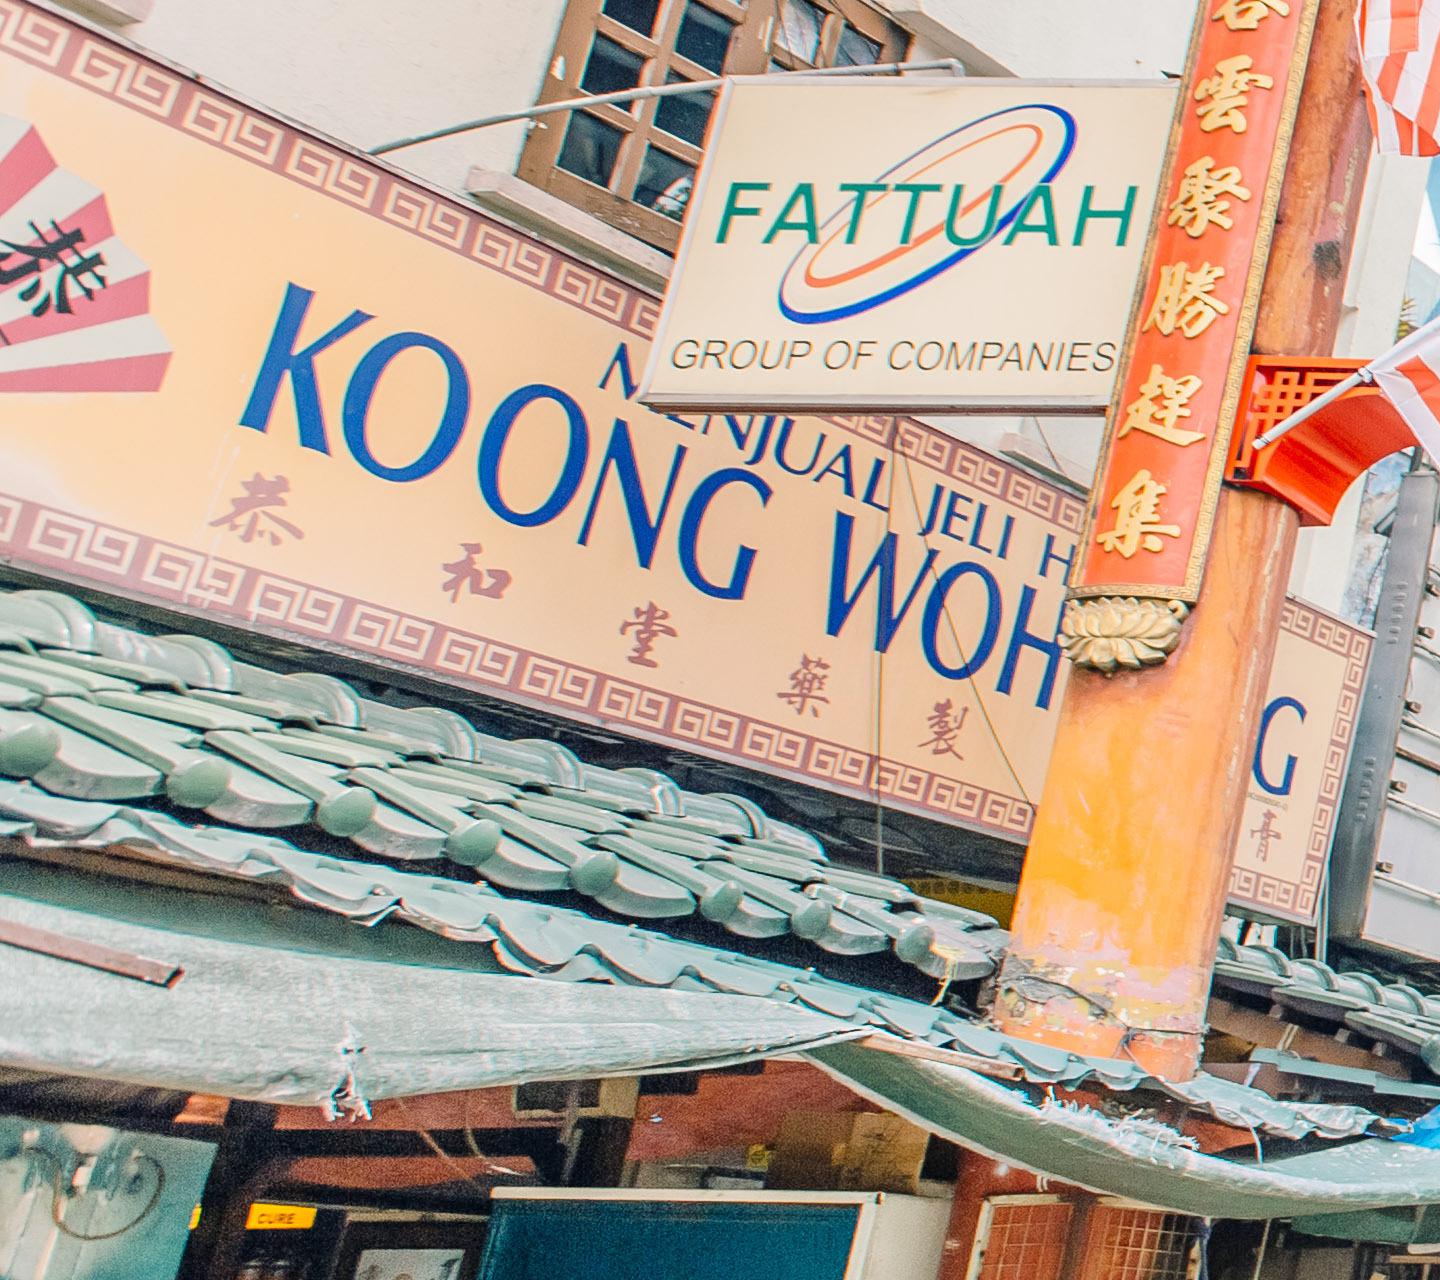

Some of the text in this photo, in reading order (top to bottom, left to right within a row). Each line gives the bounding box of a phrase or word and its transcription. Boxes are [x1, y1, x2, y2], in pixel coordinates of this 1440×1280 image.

[713, 181, 1140, 248] FATTUAH
[671, 338, 1117, 374] GROUP OF COMPANIES
[238, 280, 774, 601] KOONG
[825, 509, 1067, 712] WOH
[918, 483, 1017, 560] JELI
